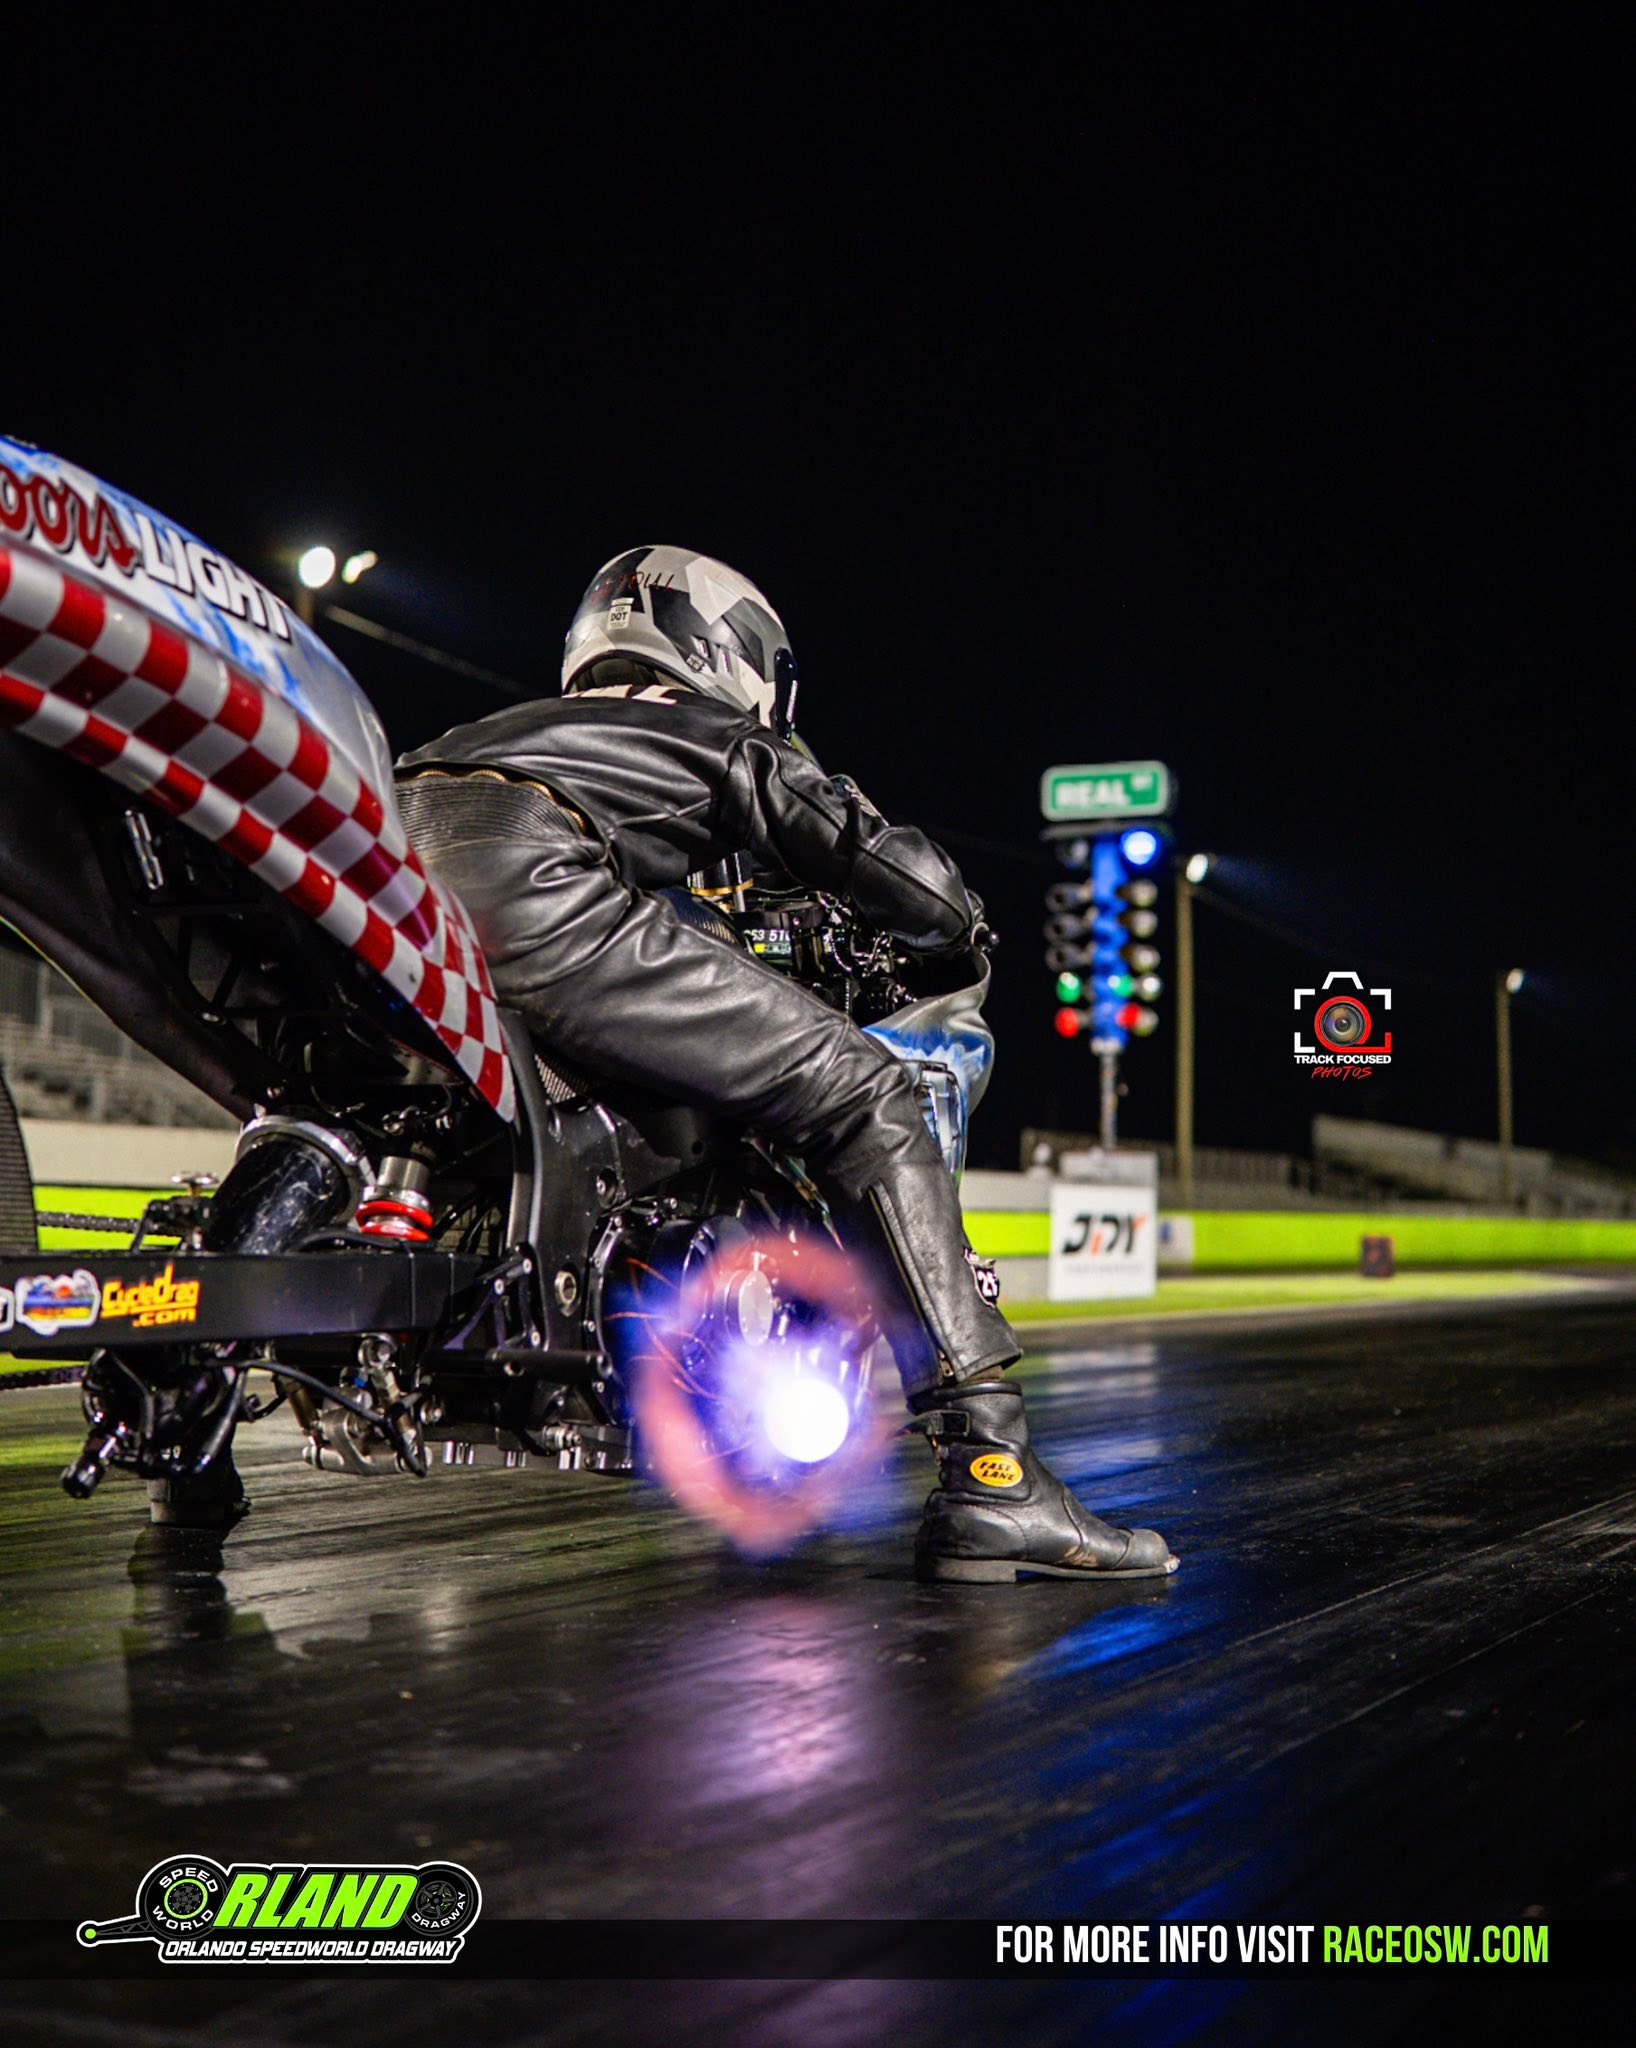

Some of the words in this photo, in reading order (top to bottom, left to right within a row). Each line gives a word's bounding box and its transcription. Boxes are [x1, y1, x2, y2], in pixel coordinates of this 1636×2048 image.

[135, 512, 292, 644] LIGHT
[610, 612, 628, 621] DOT
[1055, 778, 1131, 807] REAL
[132, 1309, 197, 1327] .com
[982, 1470, 1015, 1480] LANE
